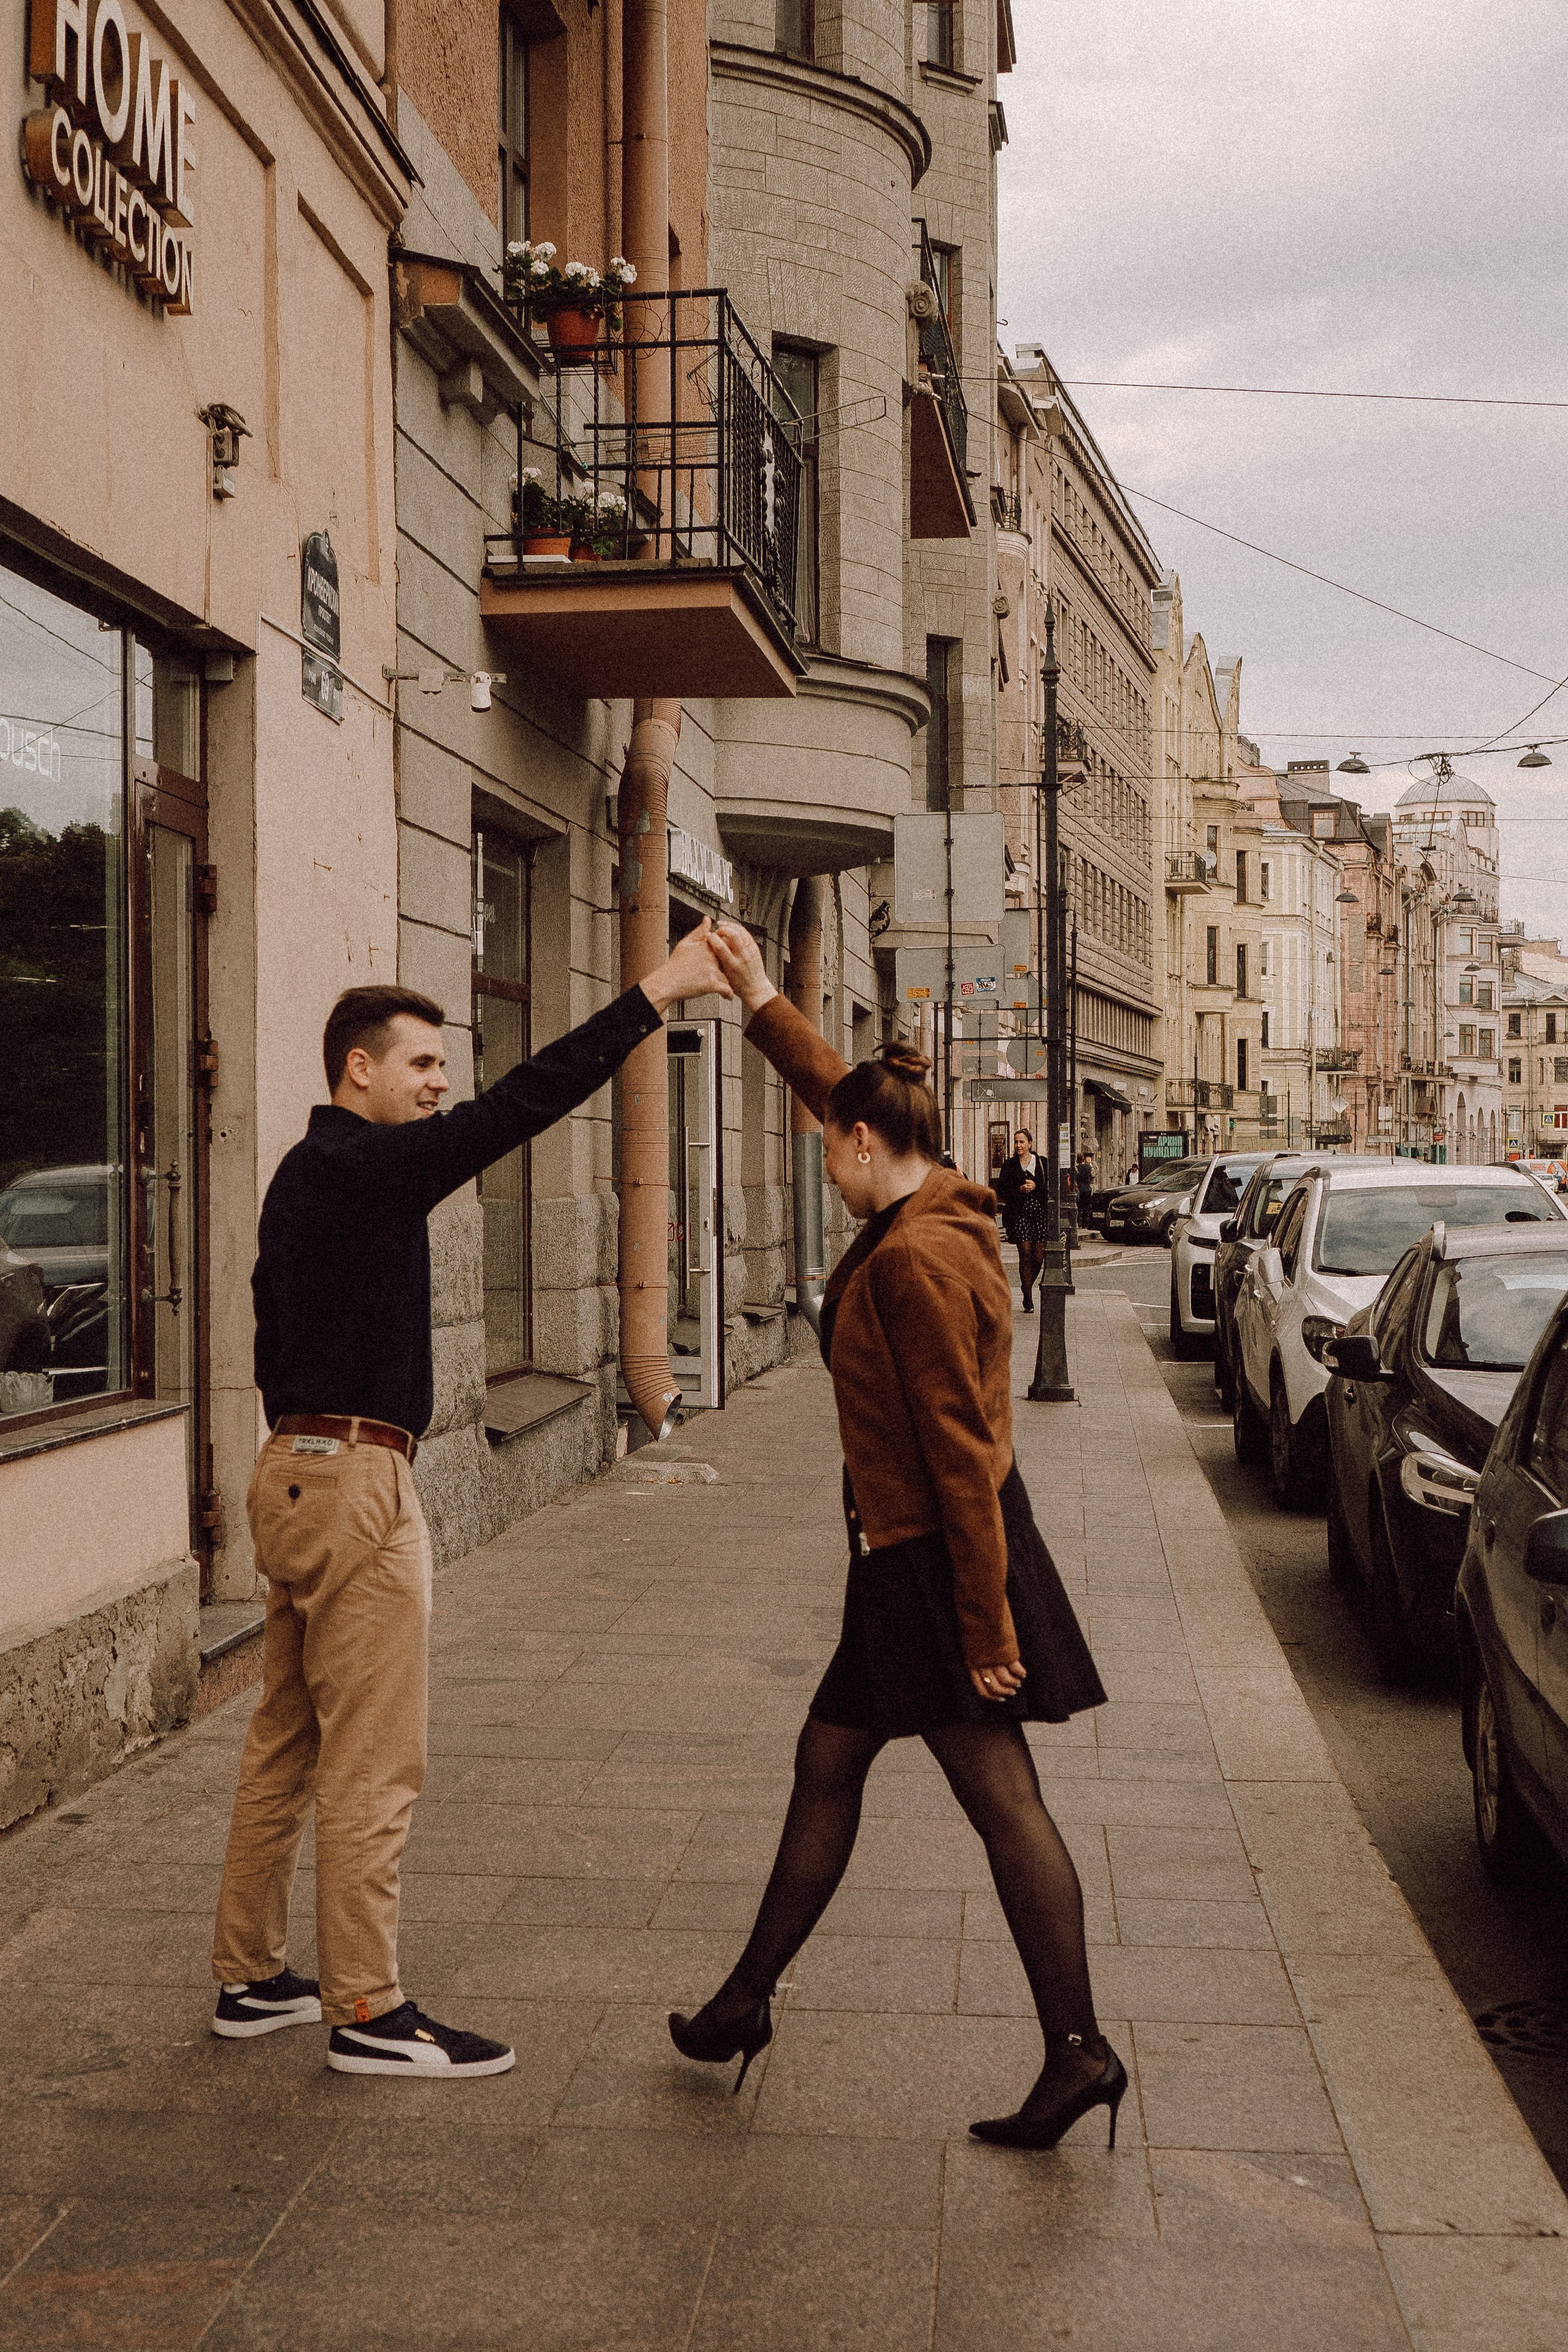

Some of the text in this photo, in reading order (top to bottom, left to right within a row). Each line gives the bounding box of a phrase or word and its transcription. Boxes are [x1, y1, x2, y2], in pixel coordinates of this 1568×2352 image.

[56, 0, 195, 227] HOME
[51, 107, 193, 315] COLLECTION
[321, 669, 330, 703] 69
[1143, 1146, 1183, 1158] КУИНДЖИ
[1158, 1135, 1183, 1147] АРХИП
